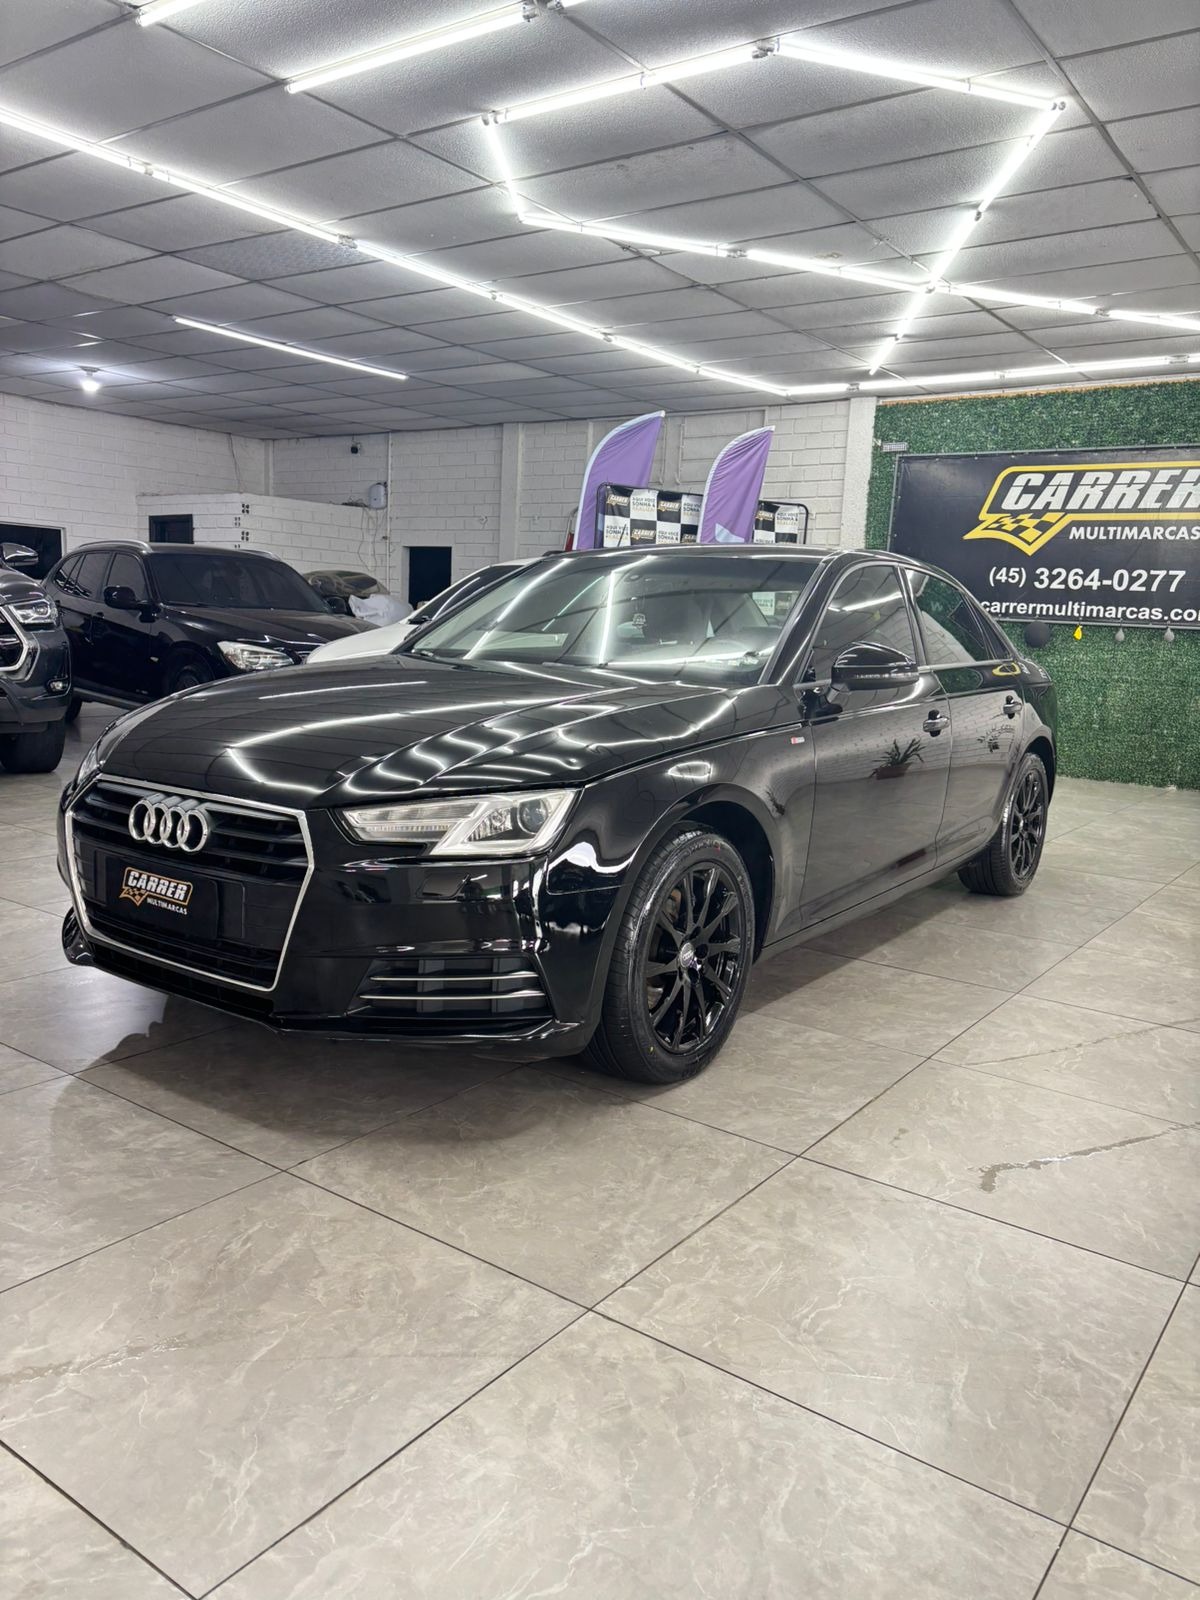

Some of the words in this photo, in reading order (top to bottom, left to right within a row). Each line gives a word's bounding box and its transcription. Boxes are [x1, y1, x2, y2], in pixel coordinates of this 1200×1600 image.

[1001, 469, 1200, 510] CARRER
[1069, 526, 1200, 541] MULTIMARCAS
[989, 566, 1027, 587] (45)
[1034, 567, 1186, 592] 3264-0277
[127, 871, 188, 901] CARRER
[146, 897, 188, 915] MULTIMARCAS
